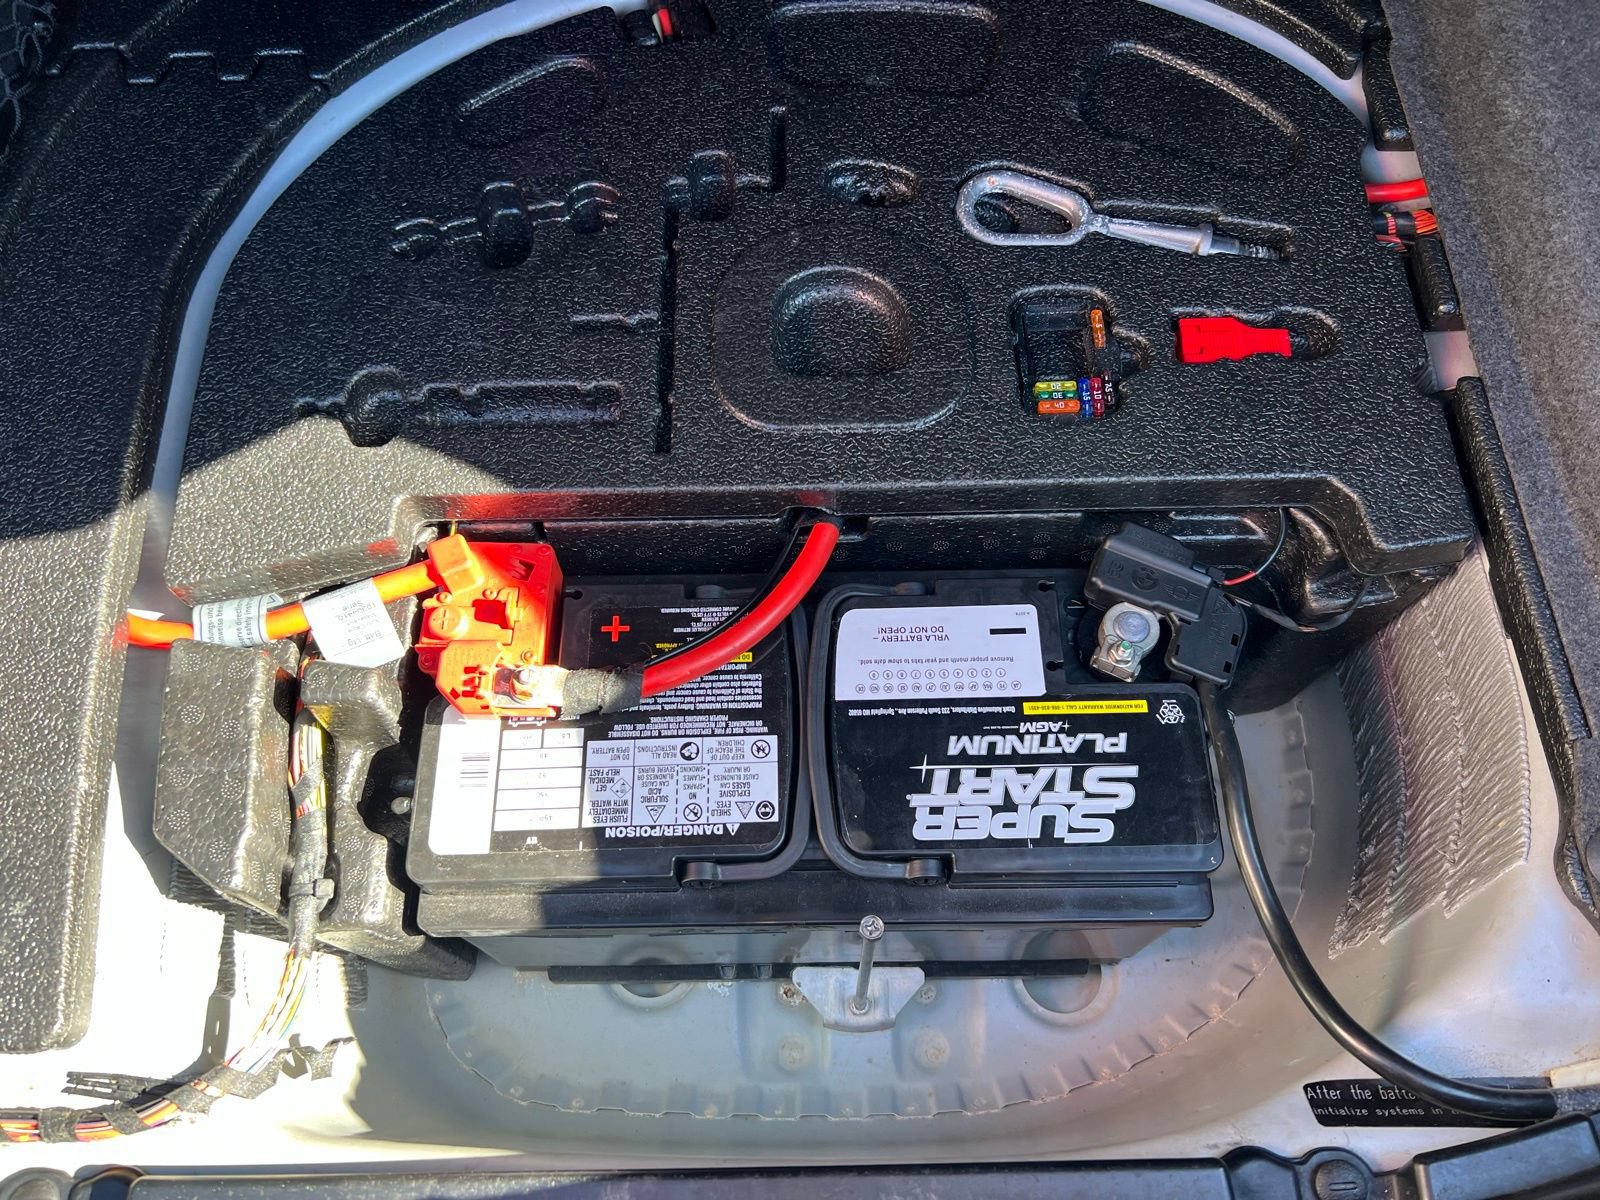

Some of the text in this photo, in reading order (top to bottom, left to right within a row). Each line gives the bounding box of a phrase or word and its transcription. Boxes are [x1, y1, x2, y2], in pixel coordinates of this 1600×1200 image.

[1082, 392, 1091, 400] 15
[1094, 390, 1102, 400] 10
[245, 616, 253, 636] safety
[1019, 722, 1063, 733] AGM
[947, 732, 1128, 755] PLATINUM
[910, 766, 1138, 810] START
[640, 795, 669, 803] SULFURIC
[588, 807, 628, 815] IMMEDIATELY
[912, 804, 1116, 844] SUPER
[605, 824, 724, 838] DANGER/POISON
[1306, 1087, 1342, 1100] After
[1350, 1084, 1373, 1100] the
[1314, 1107, 1368, 1115] initialize
[1376, 1108, 1424, 1116] systems
